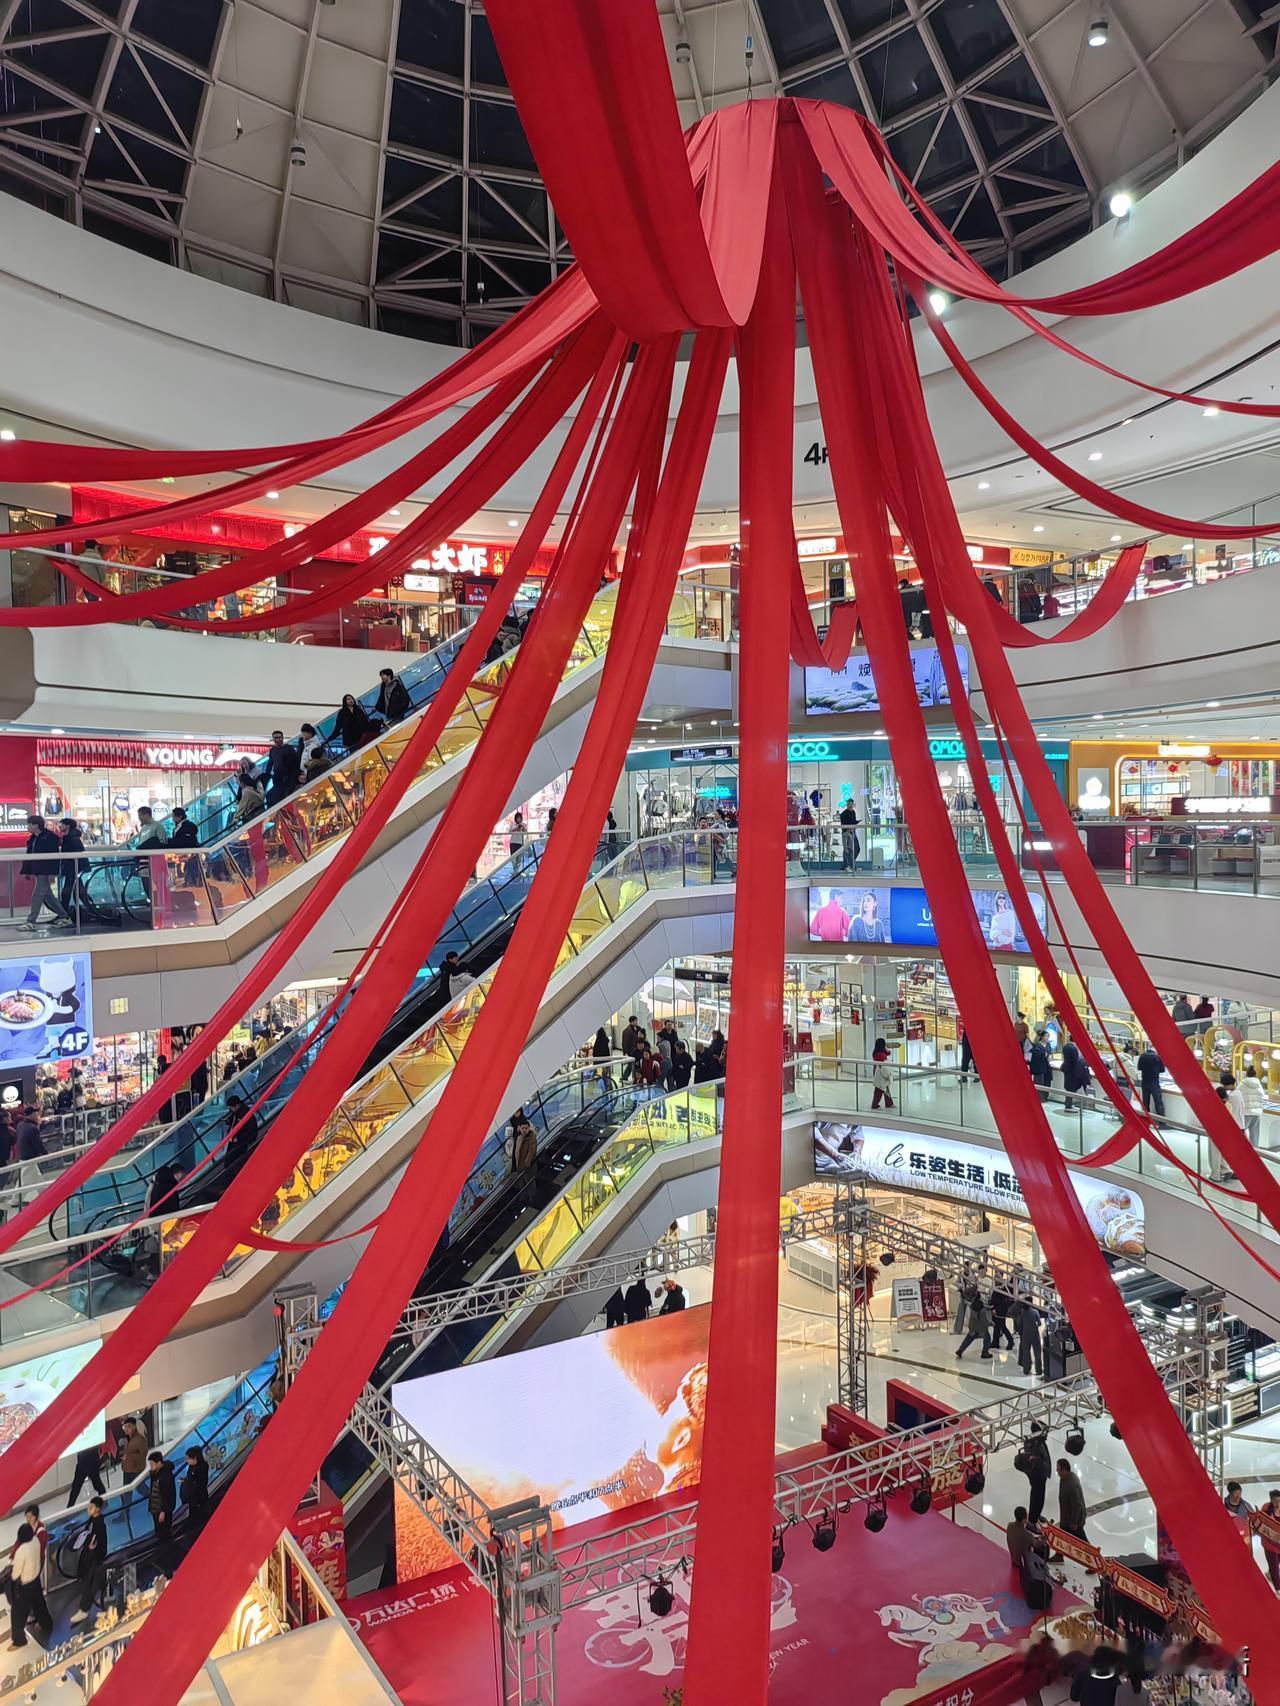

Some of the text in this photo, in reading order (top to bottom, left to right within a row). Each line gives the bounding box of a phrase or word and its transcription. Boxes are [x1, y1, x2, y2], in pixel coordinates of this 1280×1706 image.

[831, 565, 842, 575] 4F
[146, 747, 214, 766] YOUNG
[788, 742, 829, 758] OCO
[922, 908, 932, 921] U
[61, 1031, 88, 1051] 4F
[909, 1152, 985, 1184] 乐姿生活
[910, 1169, 1025, 1202] LOW TEMPERATURE SLOW FER
[360, 1581, 457, 1623] 万达广场
[369, 1593, 459, 1627] WANDA PLAZA
[769, 1638, 810, 1660] EW YEAR
